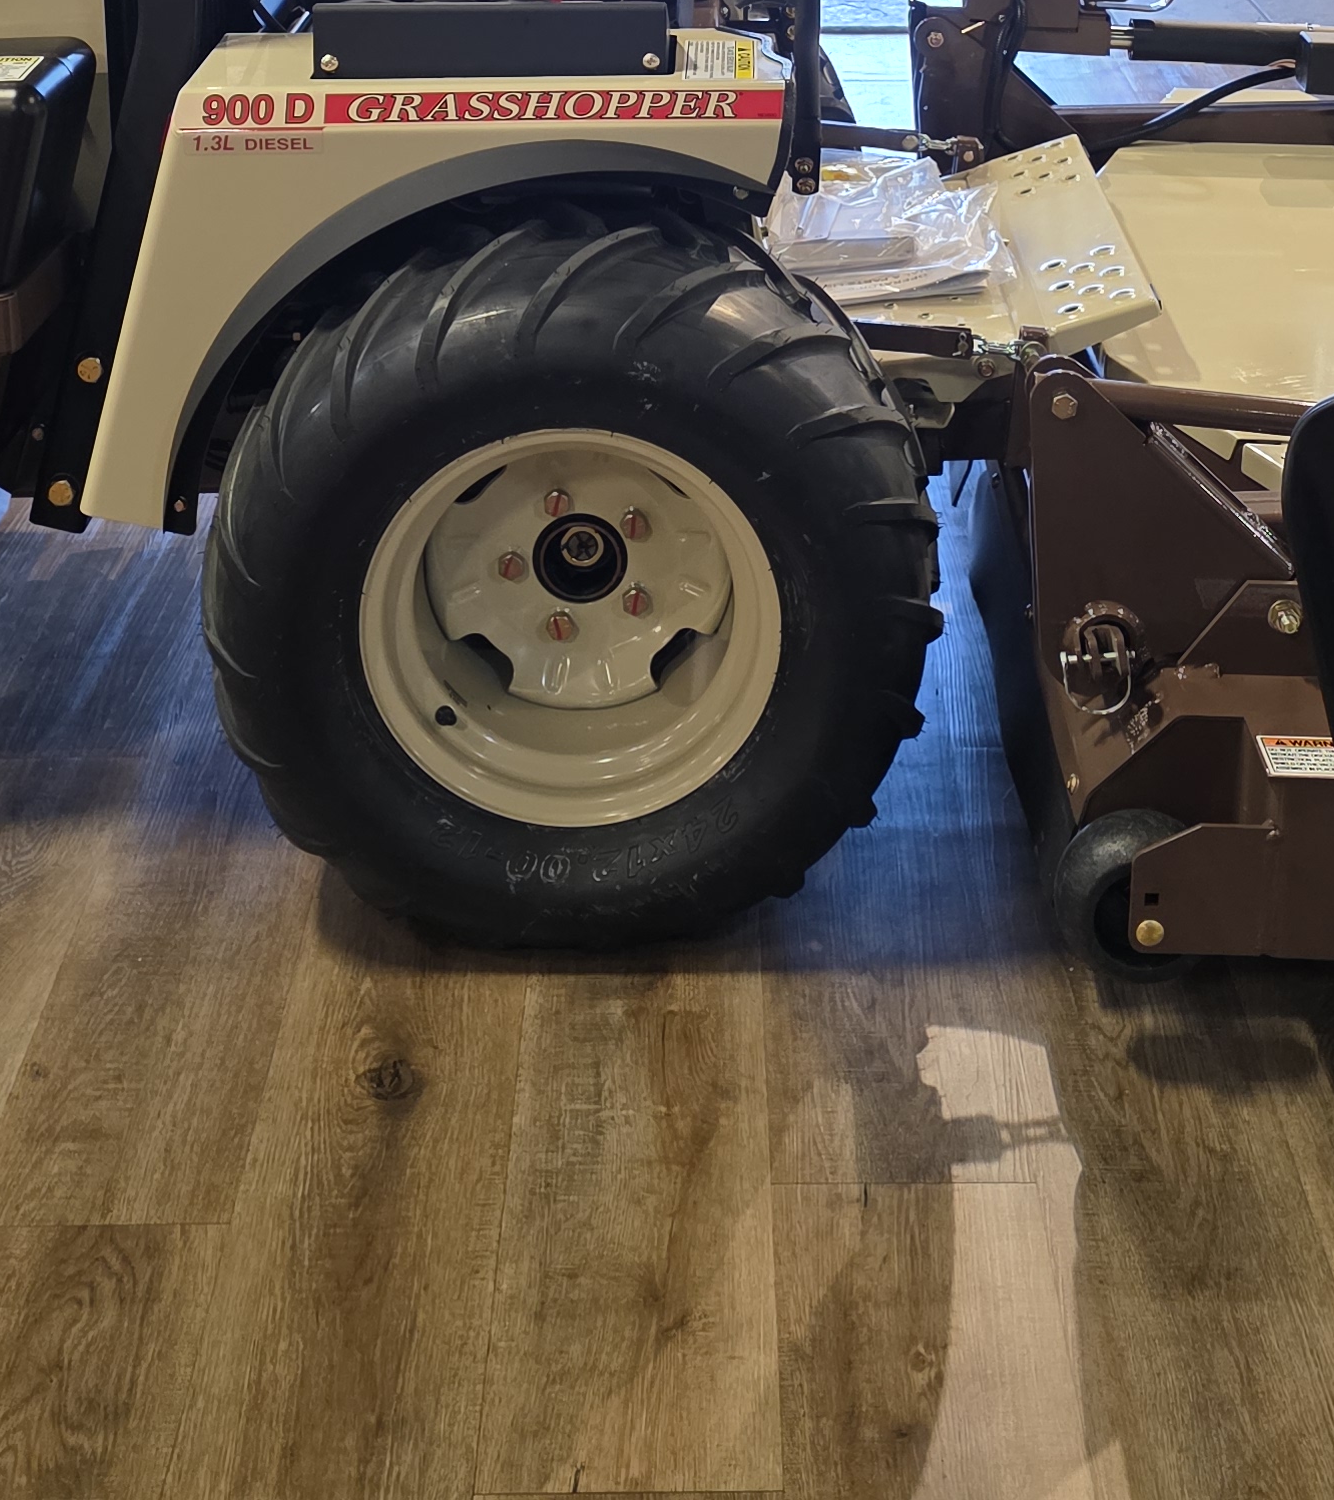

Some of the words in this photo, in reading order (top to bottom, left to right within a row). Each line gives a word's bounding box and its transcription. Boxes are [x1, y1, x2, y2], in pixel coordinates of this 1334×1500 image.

[201, 93, 275, 127] 900
[285, 93, 315, 125] D
[346, 90, 738, 123] GRASSHOPPER
[192, 134, 235, 152] 1.3L
[244, 137, 314, 152] DIESEL
[1289, 739, 1334, 747] WARN
